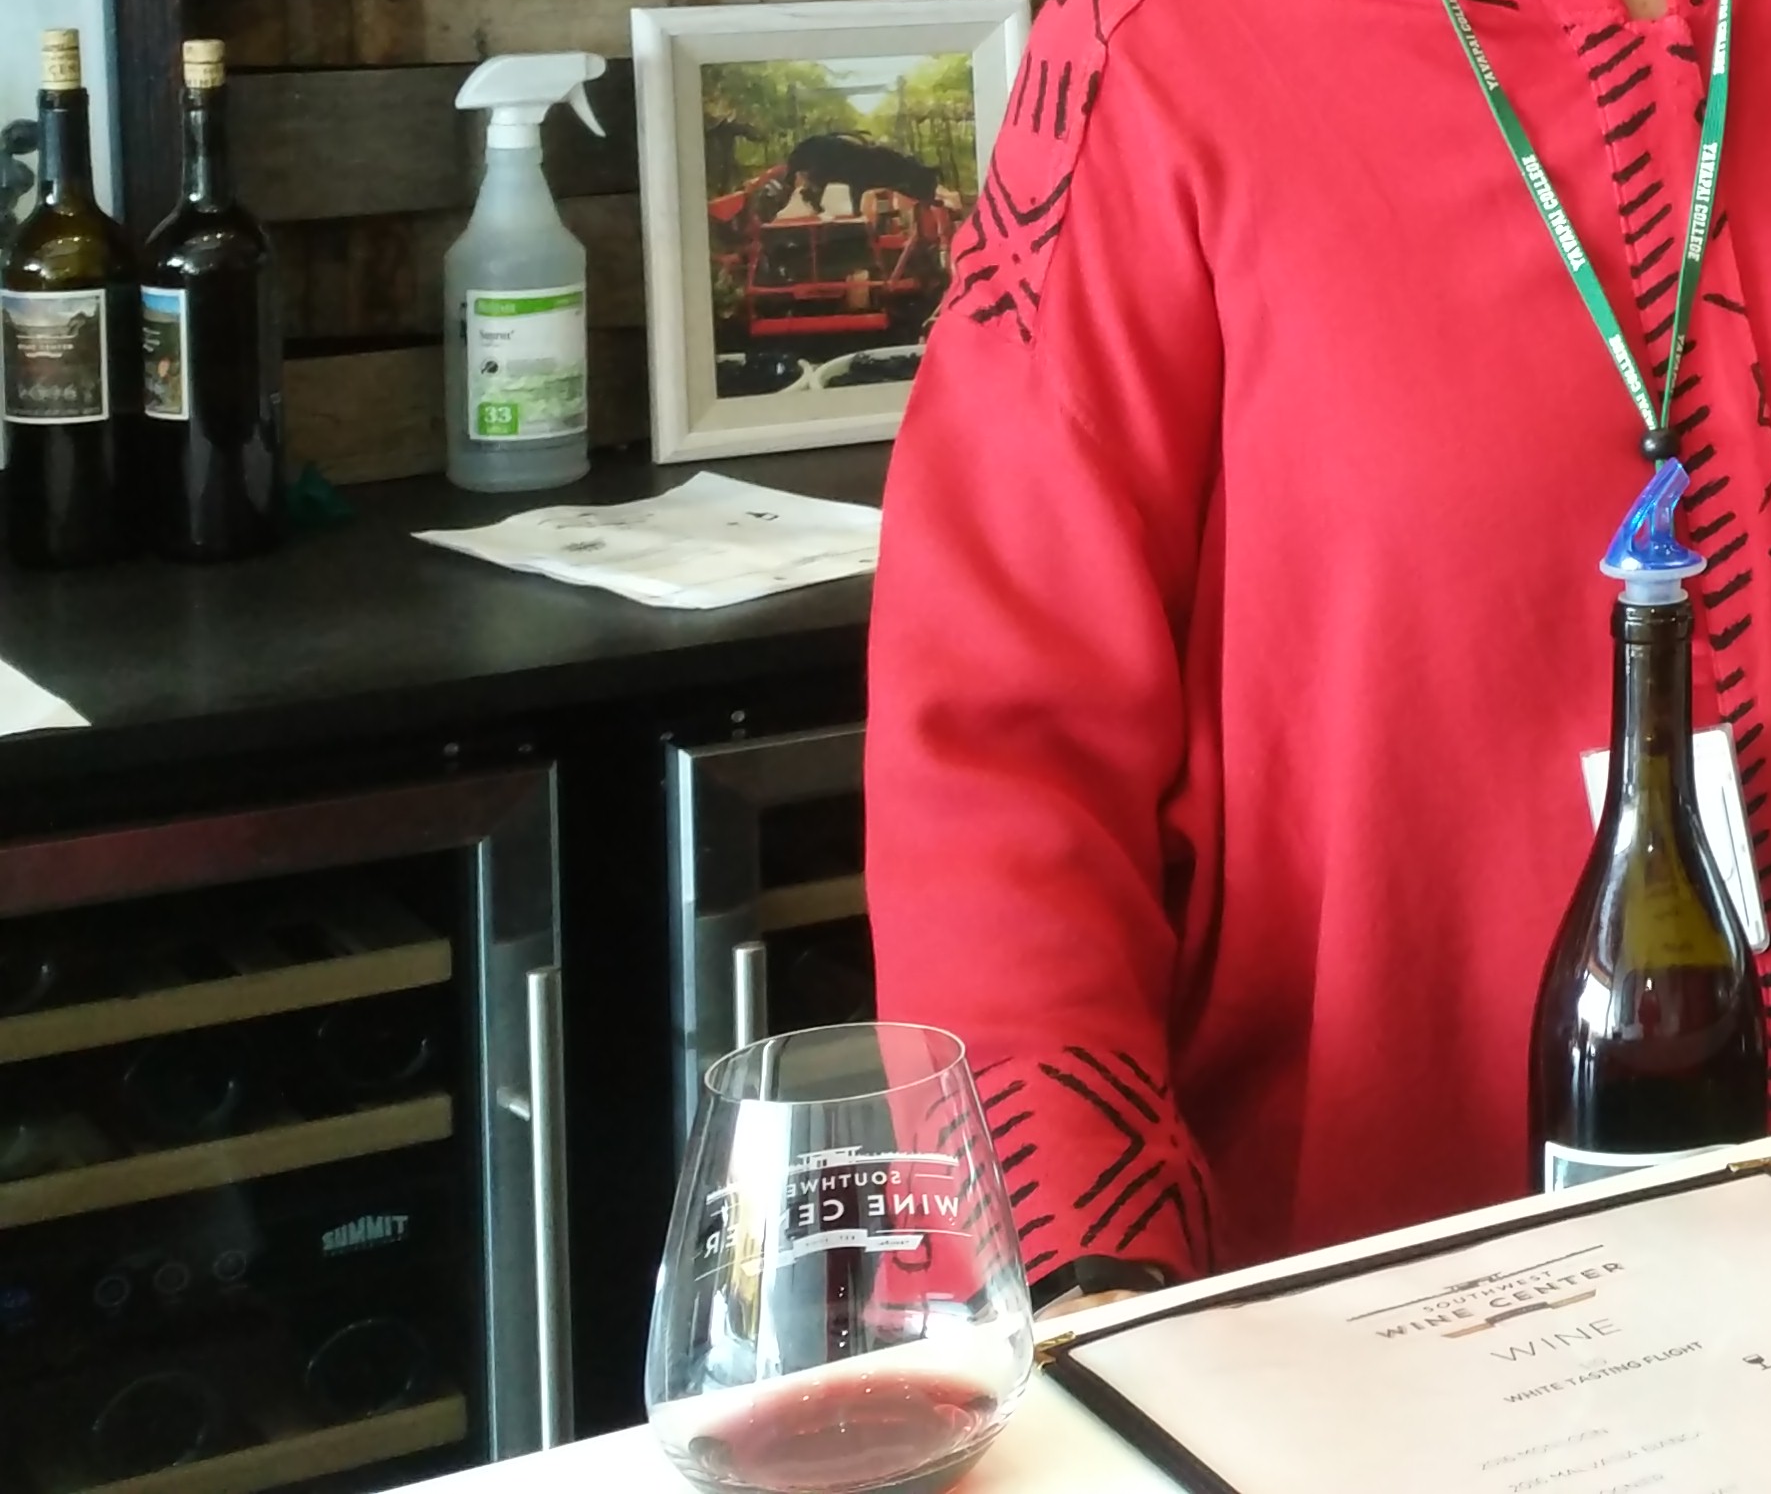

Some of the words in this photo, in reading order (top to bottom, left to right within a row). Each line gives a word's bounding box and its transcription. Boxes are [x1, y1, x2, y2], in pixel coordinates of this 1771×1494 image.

[1521, 154, 1559, 210] COLLEGE
[1696, 141, 1718, 200] YAVAPAI
[1547, 208, 1587, 272] YAVAPAI
[1687, 199, 1709, 262] COLLEGE
[483, 406, 513, 424] 33
[322, 1215, 409, 1251] SUMMIT
[1375, 1307, 1474, 1339] WINE
[1488, 1261, 1626, 1309] CENTER
[1422, 1270, 1553, 1313] SOUTHWEST
[1490, 1317, 1623, 1363] WINE
[1503, 1382, 1564, 1404] WHITE
[1565, 1359, 1642, 1387] TASTING
[1642, 1340, 1704, 1366] FLIGHT
